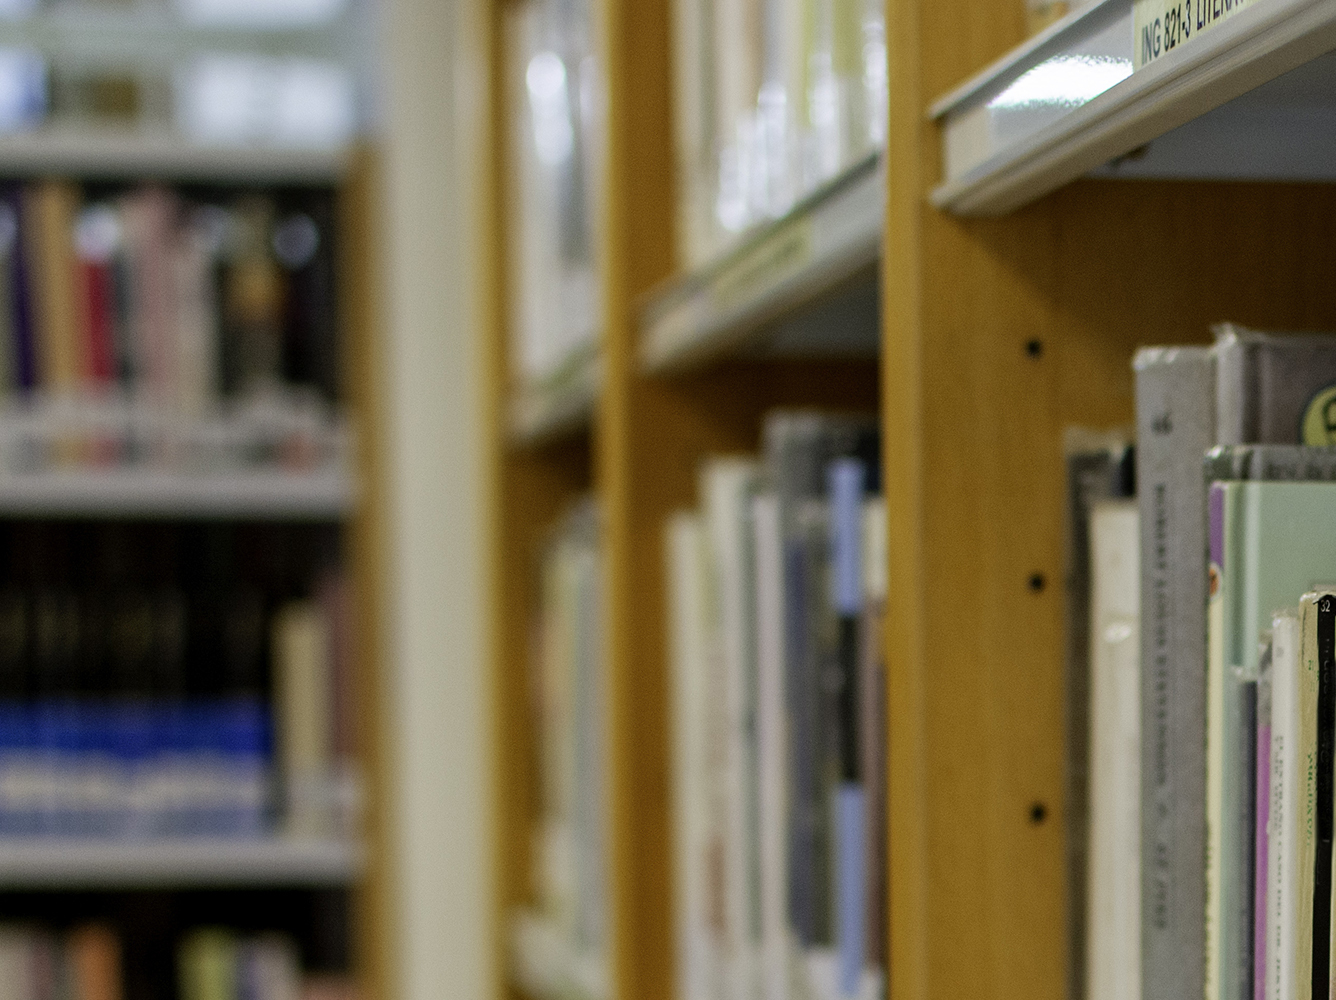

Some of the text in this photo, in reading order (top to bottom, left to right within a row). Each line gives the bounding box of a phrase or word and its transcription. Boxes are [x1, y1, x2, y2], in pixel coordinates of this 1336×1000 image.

[1141, 18, 1161, 65] ING
[1163, 0, 1191, 52] 821-3
[1320, 599, 1331, 613] 32
